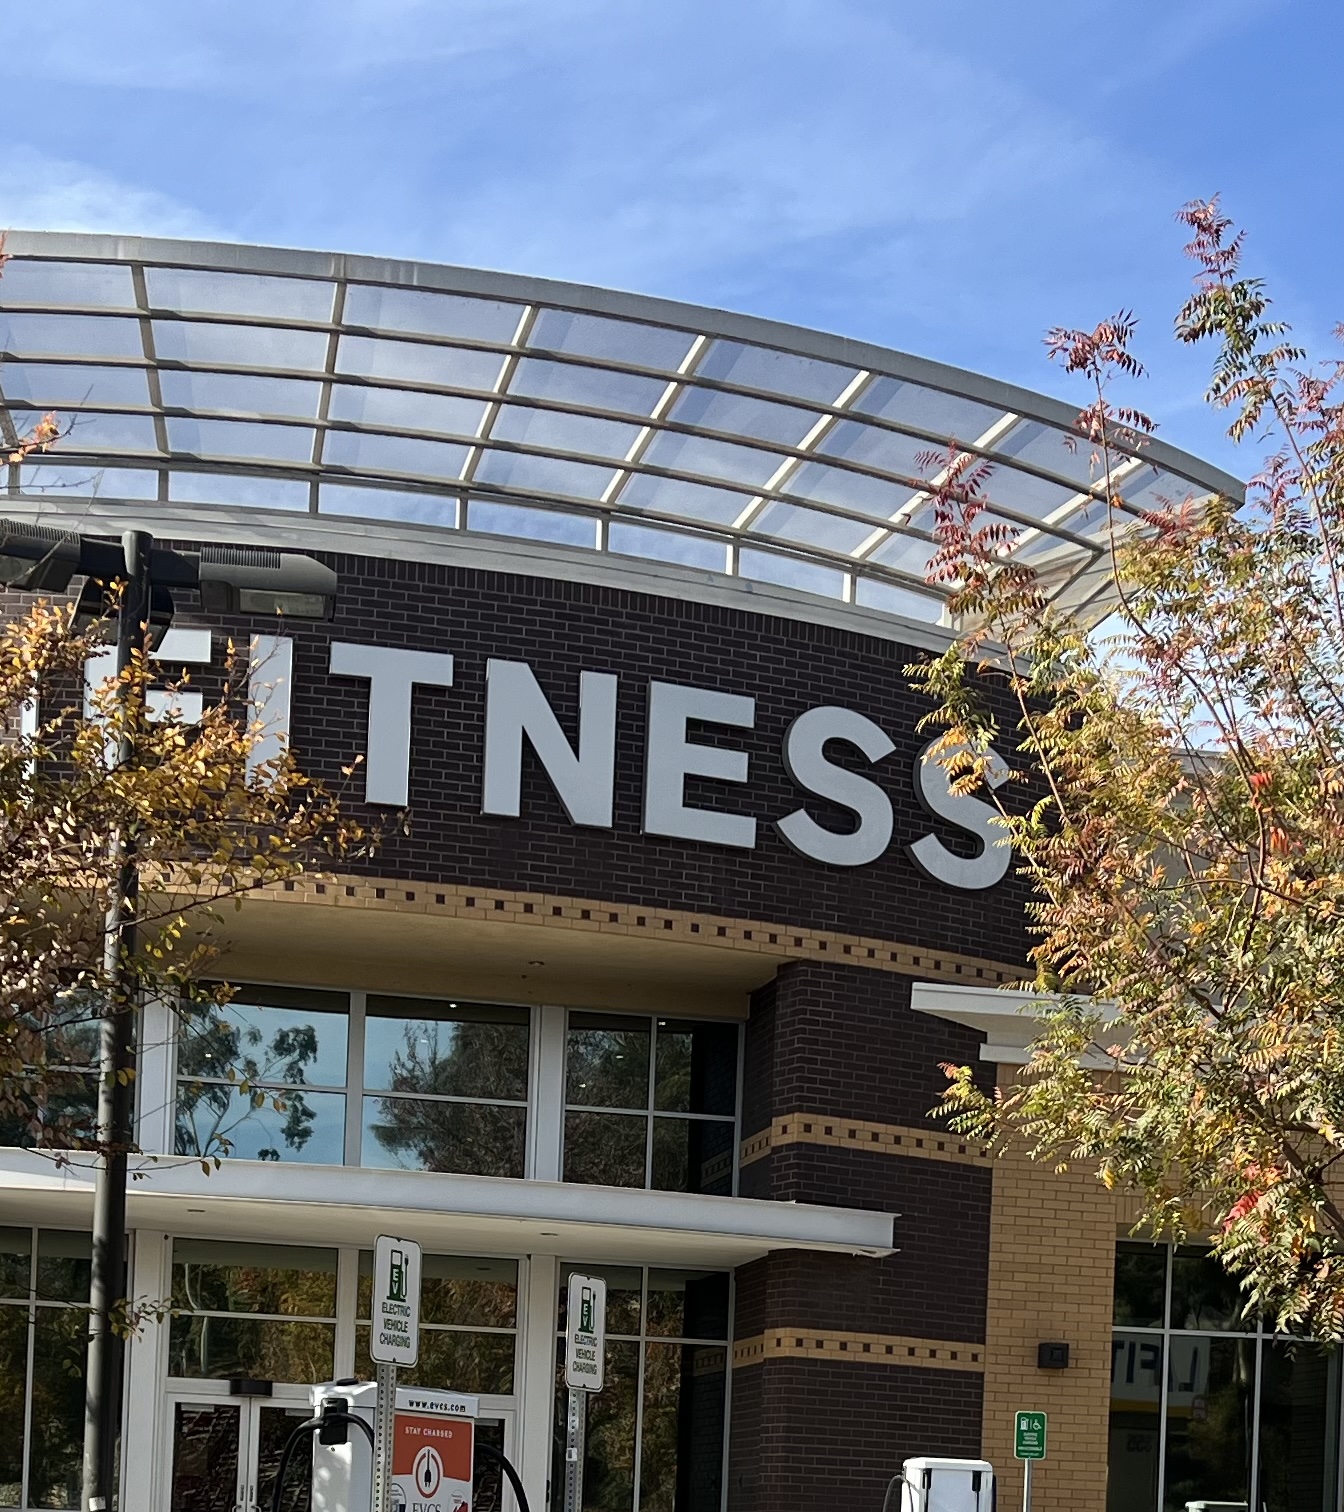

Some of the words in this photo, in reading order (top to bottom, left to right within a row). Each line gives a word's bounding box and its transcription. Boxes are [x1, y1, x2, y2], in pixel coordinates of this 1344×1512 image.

[391, 1268, 399, 1295] EV
[381, 1301, 411, 1318] ELECTRIC
[582, 1303, 589, 1327] EV
[383, 1318, 408, 1334] VEHICLE
[379, 1332, 410, 1349] CHARGING
[575, 1347, 596, 1361] VEHICLE
[408, 1399, 466, 1413] www.evcs.com
[404, 1426, 421, 1435] STAY
[422, 1427, 453, 1439] CHARGED
